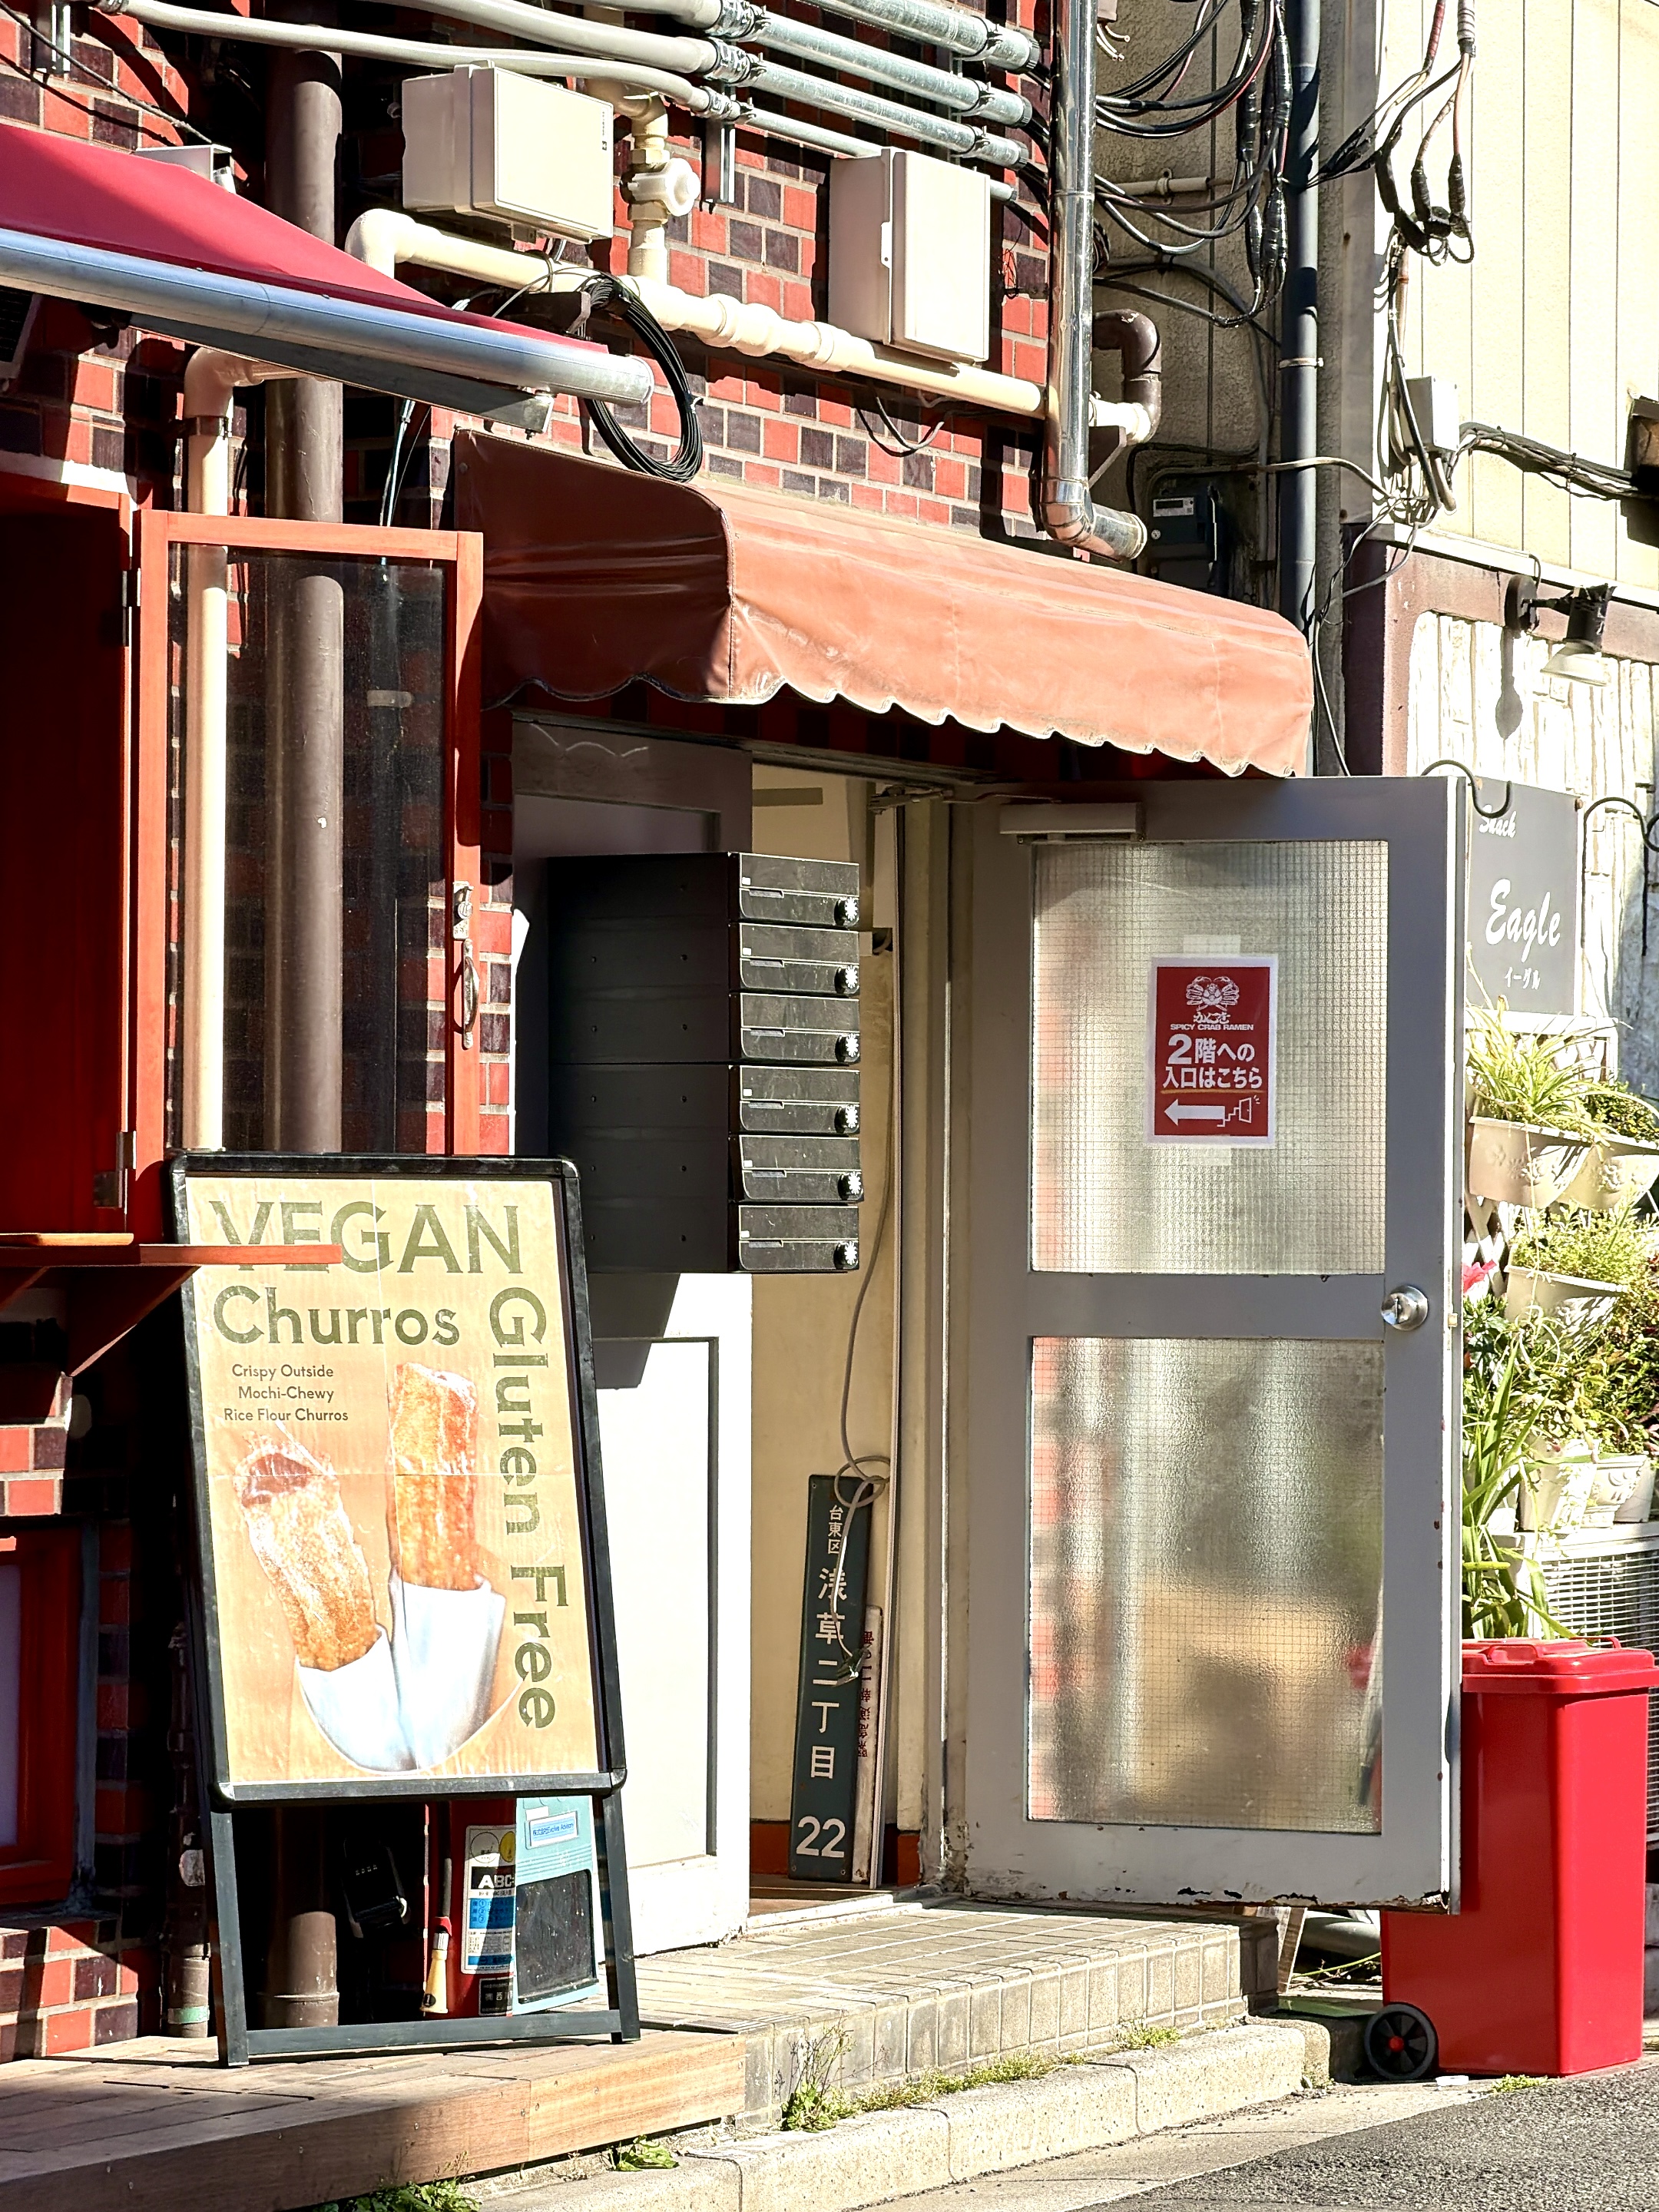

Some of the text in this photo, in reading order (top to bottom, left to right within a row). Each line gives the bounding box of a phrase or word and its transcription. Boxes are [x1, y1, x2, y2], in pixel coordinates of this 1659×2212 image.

[1485, 879, 1561, 963] Eagle
[1505, 966, 1541, 990] イーグル
[1167, 1034, 1255, 1065] 2階への
[1162, 1066, 1263, 1089] 入口はこちら
[209, 1200, 522, 1275] VEGAN
[213, 1285, 460, 1346] Churros
[231, 1364, 334, 1380] Crispy Outside
[238, 1386, 335, 1402] Mochi-Chewy
[224, 1408, 349, 1421] Rice Flour Churros
[489, 1286, 547, 1536] Gluten
[827, 1505, 843, 1555] 台東区
[510, 1565, 568, 1729] Free
[809, 1568, 848, 1780] 浅草二丁目
[796, 1816, 845, 1857] 22
